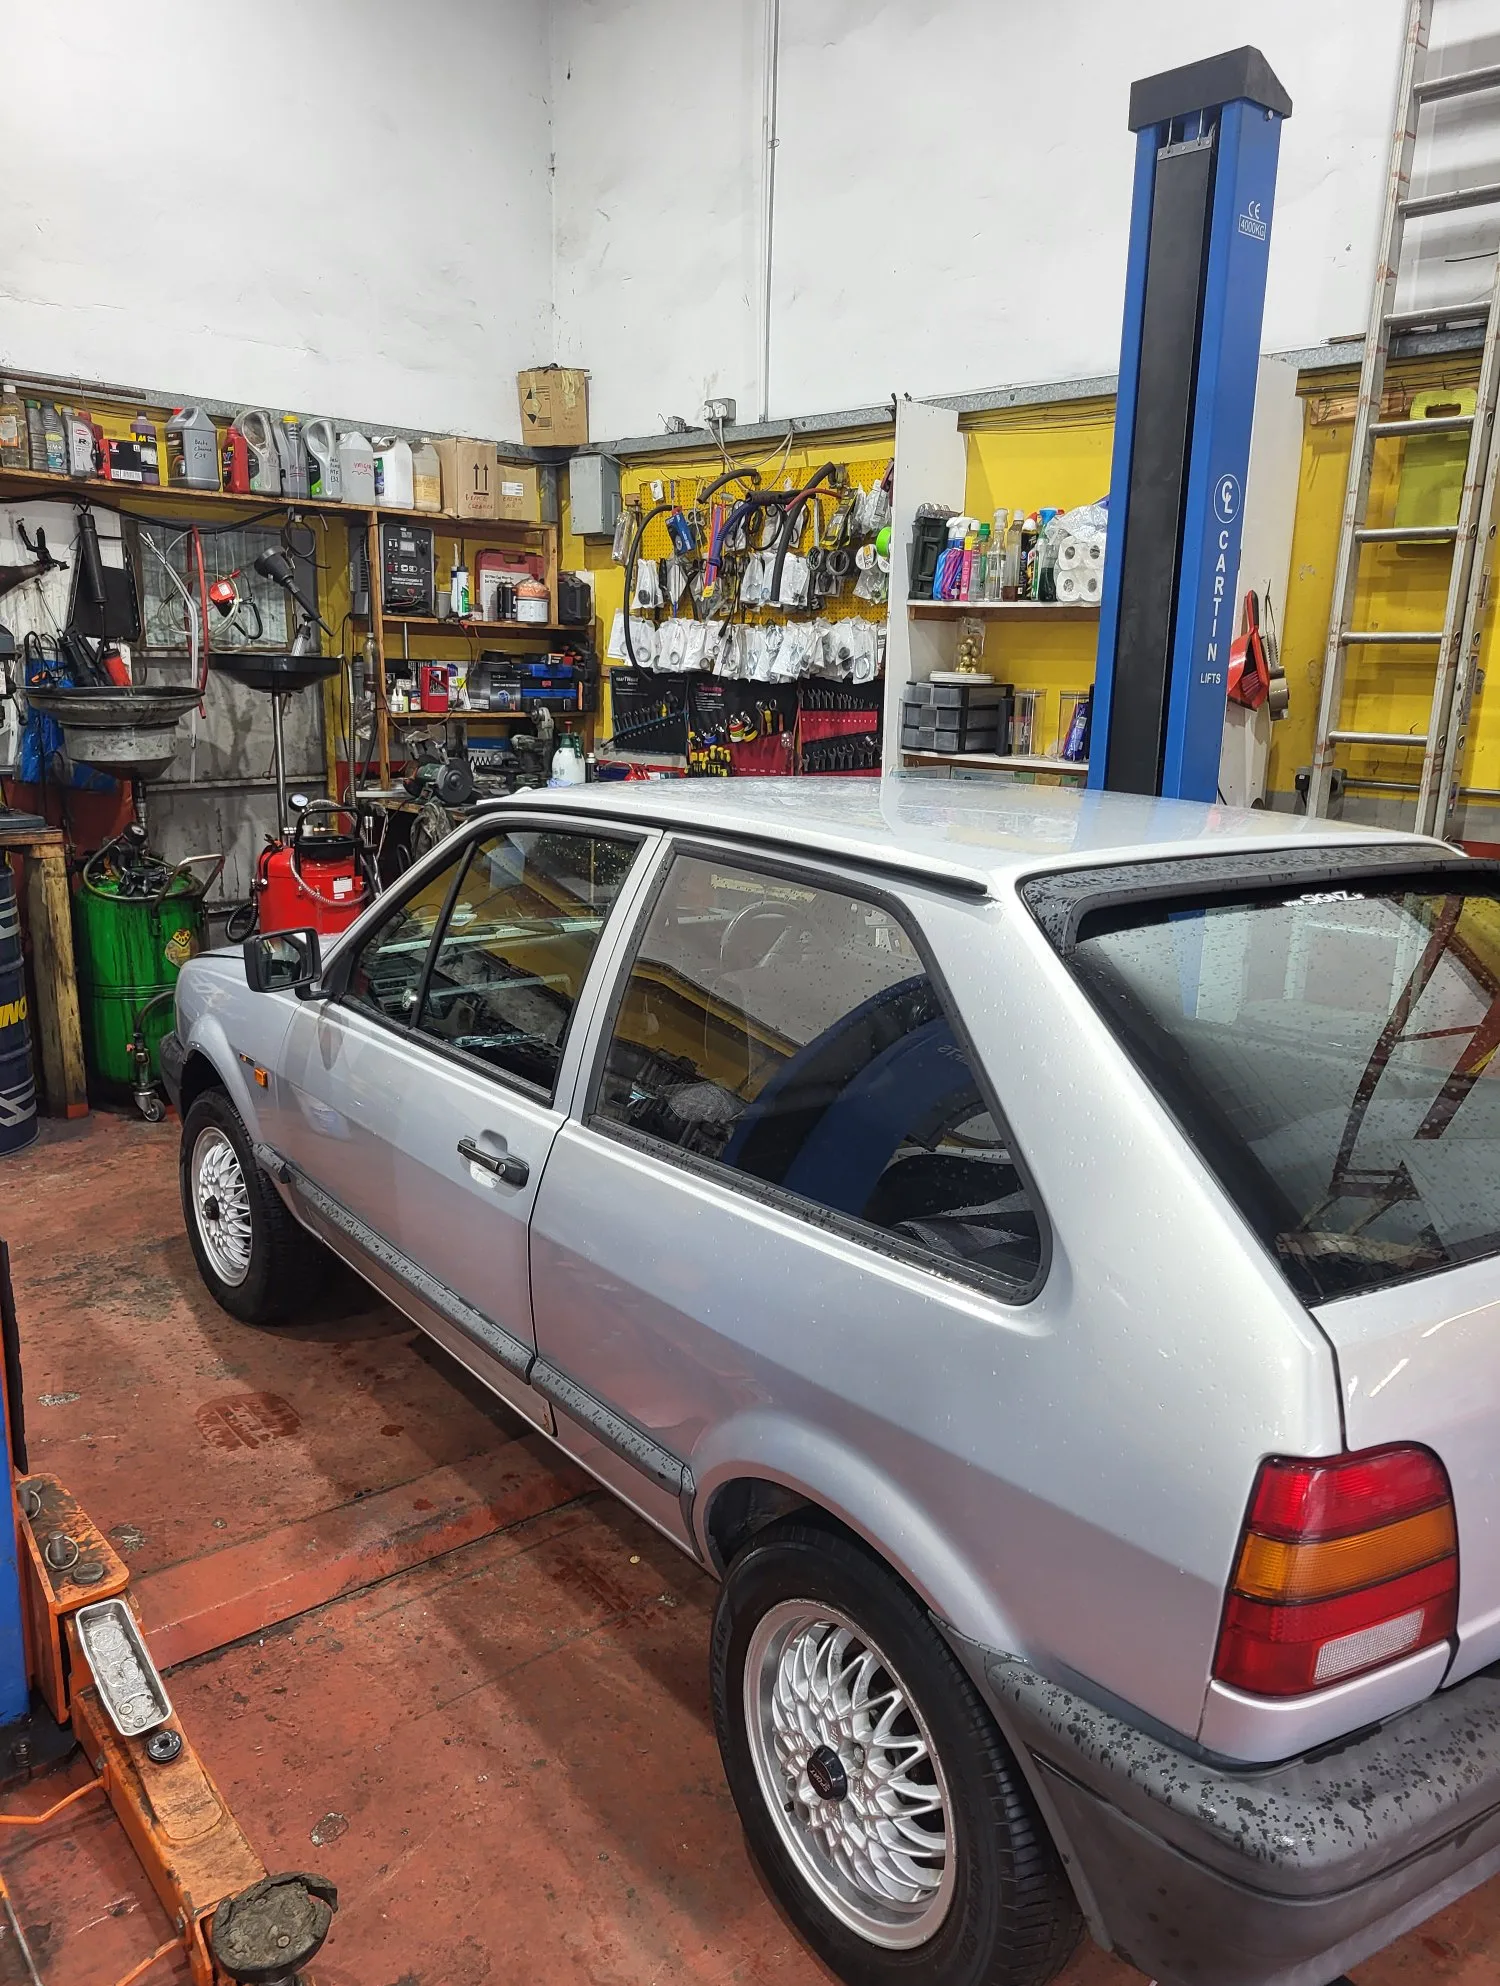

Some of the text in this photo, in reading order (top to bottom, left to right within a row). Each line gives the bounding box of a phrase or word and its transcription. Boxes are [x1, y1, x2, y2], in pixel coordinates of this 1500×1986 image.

[1248, 200, 1261, 220] CE
[1240, 219, 1265, 237] 4000KG
[1207, 530, 1229, 662] CARTIN
[1200, 672, 1221, 685] LIFTS
[810, 1769, 831, 1792] SPORT
